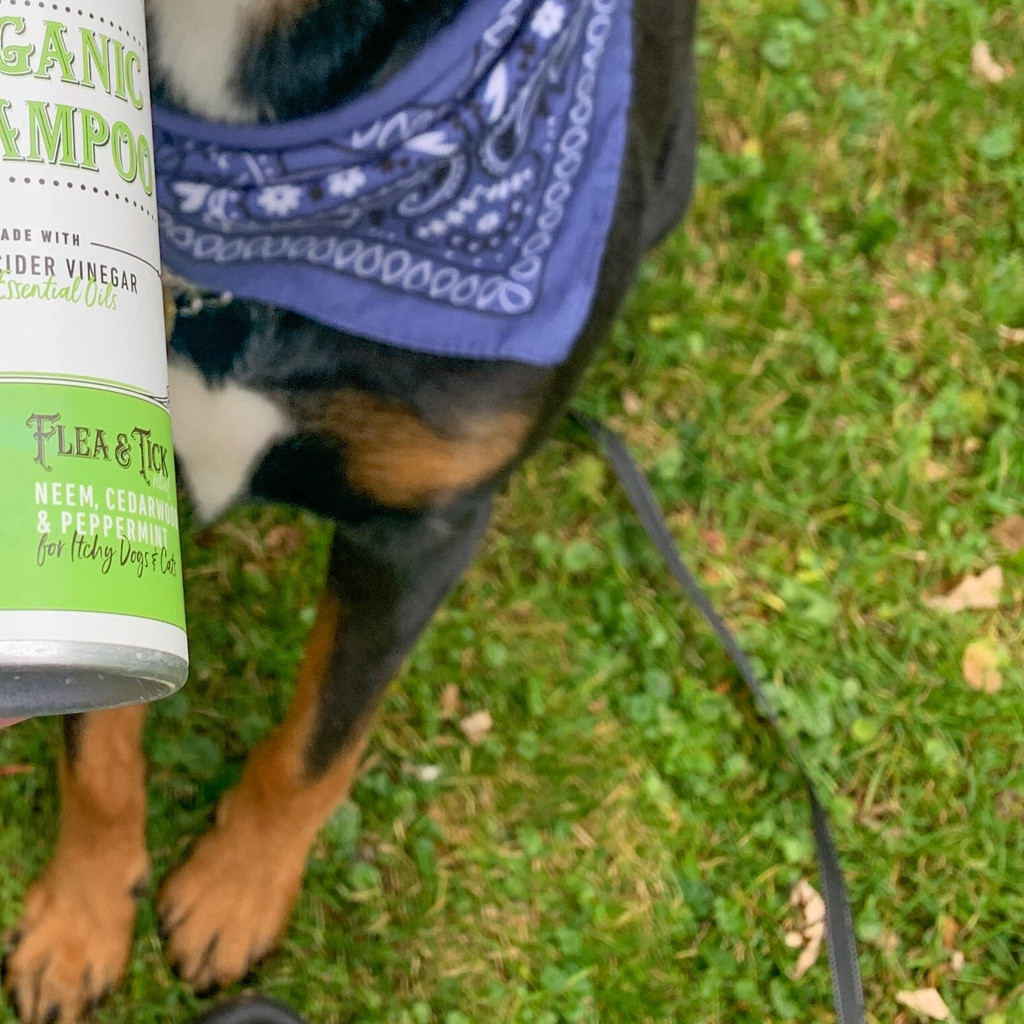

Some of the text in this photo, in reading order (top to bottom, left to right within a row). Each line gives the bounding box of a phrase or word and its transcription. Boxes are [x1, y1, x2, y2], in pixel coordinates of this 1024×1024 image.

[40, 230, 81, 247] WITH
[65, 258, 139, 295] VINEGAR
[83, 278, 118, 311] Oils
[26, 413, 169, 488] FLEA & TICK
[35, 481, 99, 511] NEEM,
[36, 510, 168, 549] & PEPPERMINT
[36, 533, 66, 567] for
[71, 530, 116, 575] Itchy
[119, 535, 149, 579] Dogs
[160, 547, 177, 577] Cats
